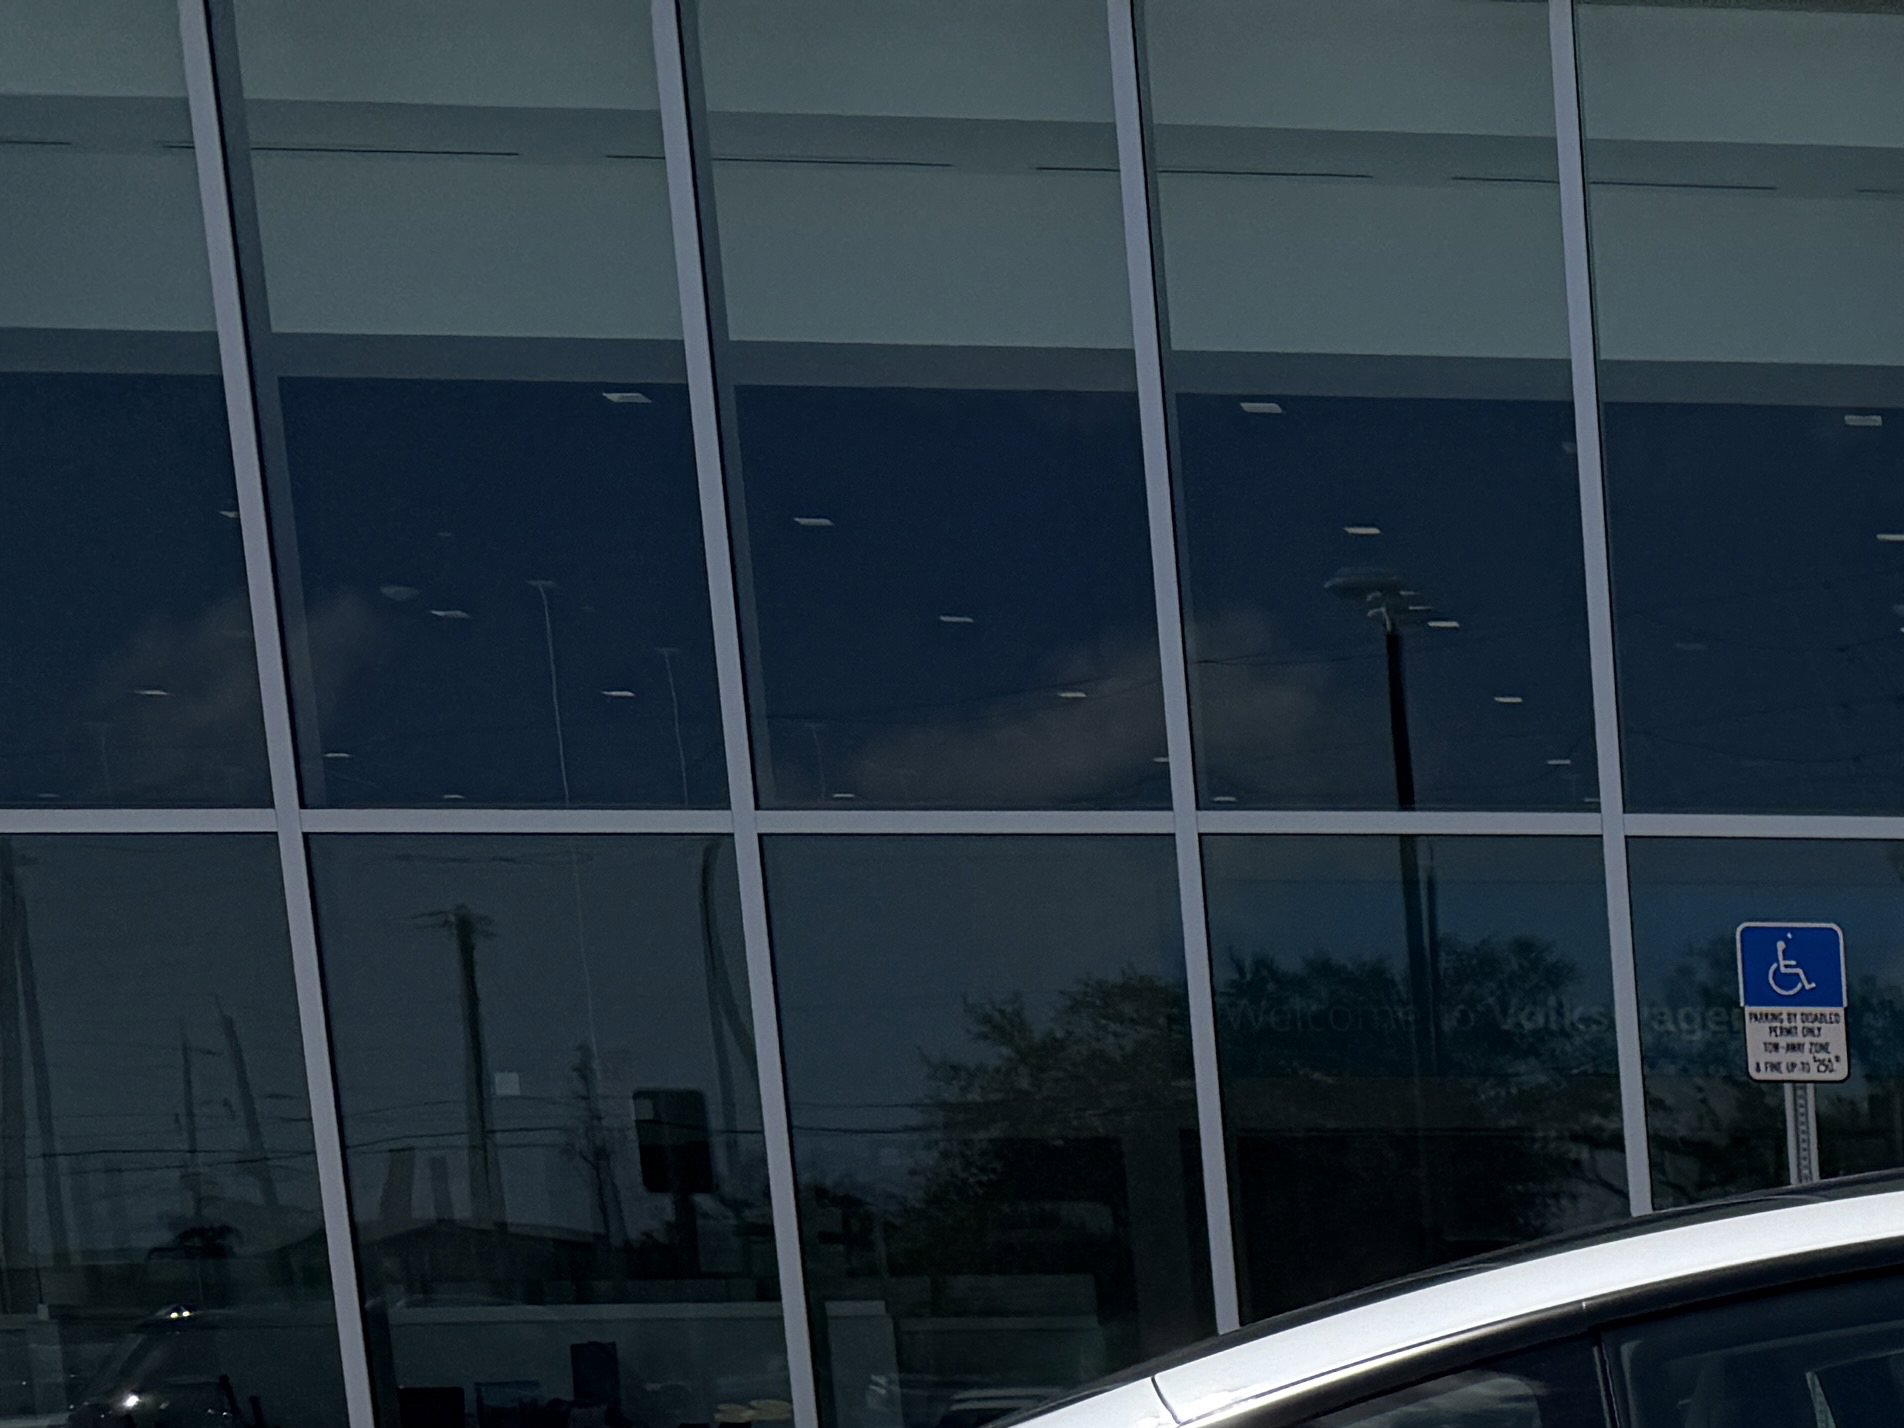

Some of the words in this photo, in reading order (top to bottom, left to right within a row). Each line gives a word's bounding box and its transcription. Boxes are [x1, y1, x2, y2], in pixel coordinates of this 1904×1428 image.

[1749, 1012, 1783, 1024] PARKING
[1786, 1012, 1797, 1024] BY
[1800, 1012, 1840, 1024] DISABLED
[1768, 1026, 1798, 1037] PERMIT
[1802, 1026, 1822, 1037] ONLY
[1763, 1042, 1805, 1053] TOW-AWAY
[1809, 1042, 1830, 1054] ZONE
[1764, 1061, 1783, 1073] FINE
[1786, 1062, 1797, 1073] UP
[1800, 1062, 1811, 1073] TO
